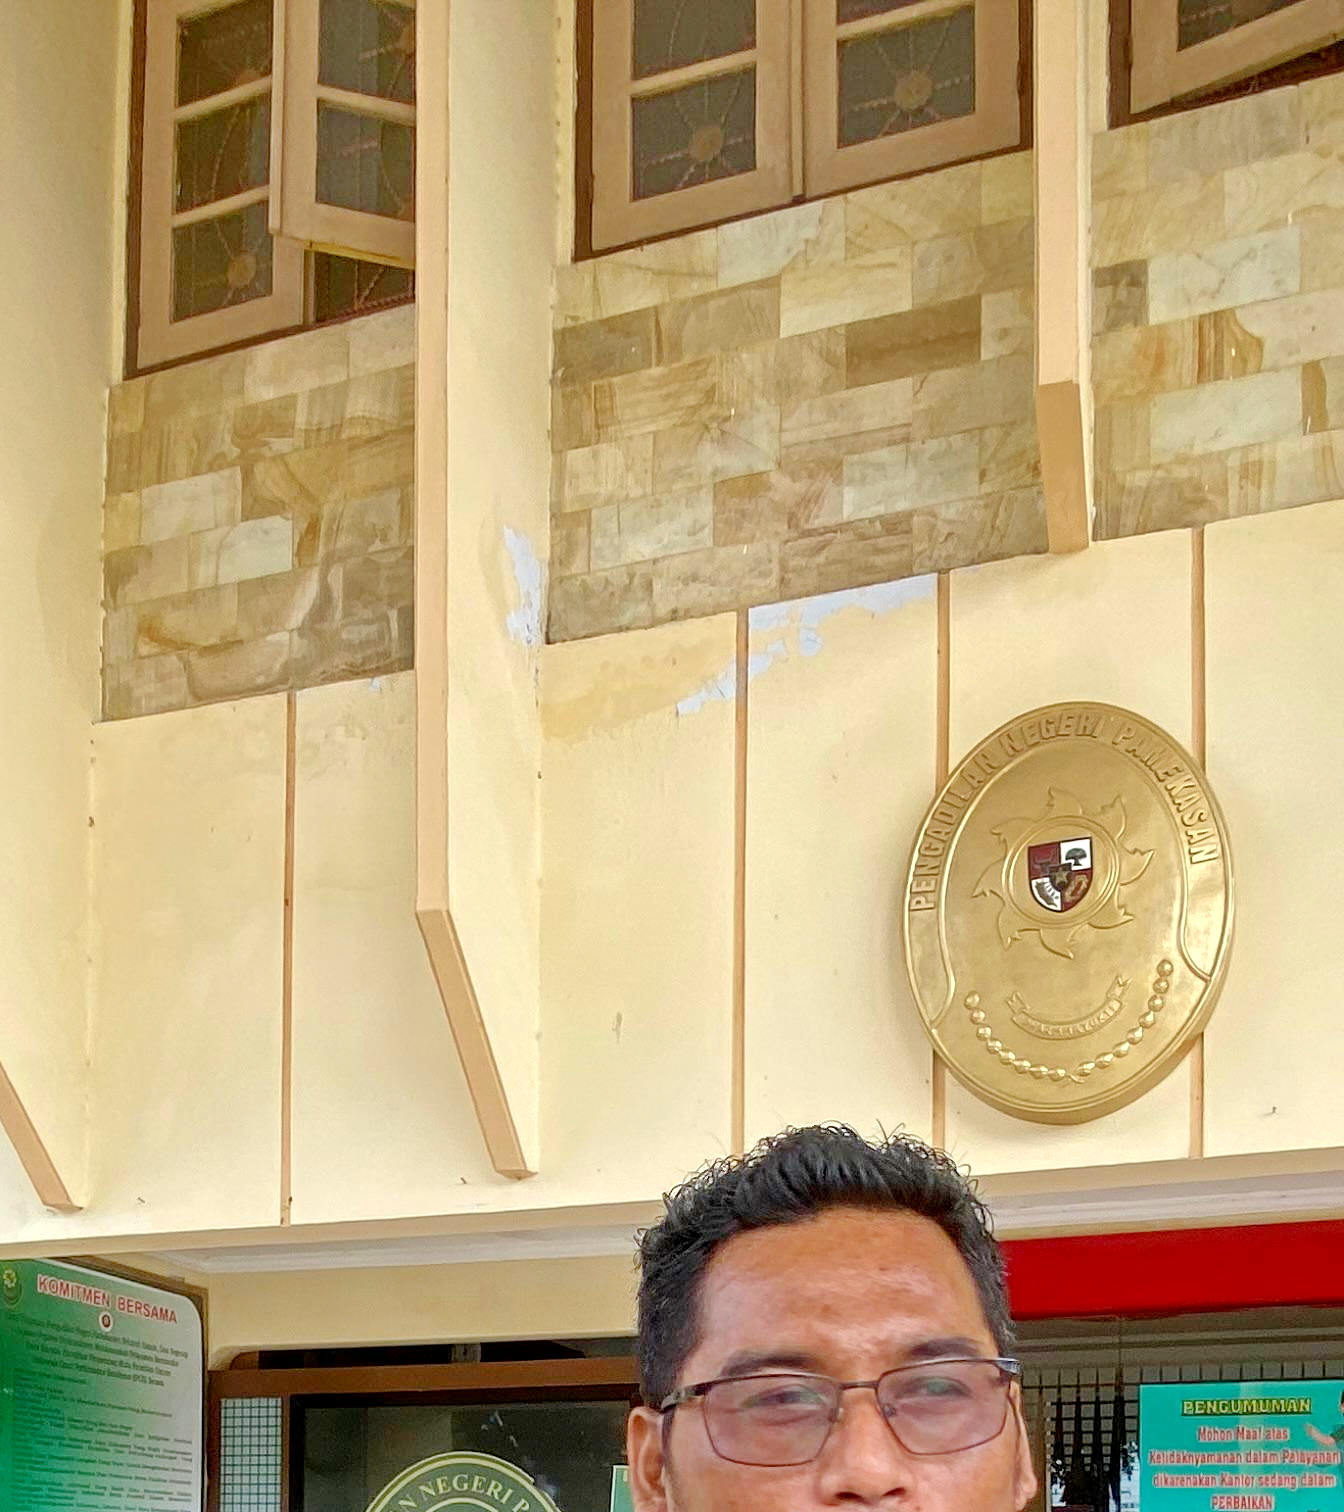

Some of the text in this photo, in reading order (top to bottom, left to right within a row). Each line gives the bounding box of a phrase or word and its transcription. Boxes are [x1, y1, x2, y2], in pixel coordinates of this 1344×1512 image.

[1003, 711, 1102, 757] NEGERI
[1111, 722, 1219, 865] PAMEKASAN
[37, 1274, 178, 1323] KOMITMEN BERSAMA
[1183, 1399, 1312, 1415] PENGUMUMAN
[1197, 1426, 1289, 1441] Mohon Maaf atas
[1149, 1449, 1341, 1466] Ketidaknyamanan dalam Pelayanan
[1153, 1474, 1337, 1489] dikarenakan Kantor sedang dalam
[419, 1473, 513, 1507] NEGERI
[1211, 1495, 1274, 1510] PERBAIKAN
